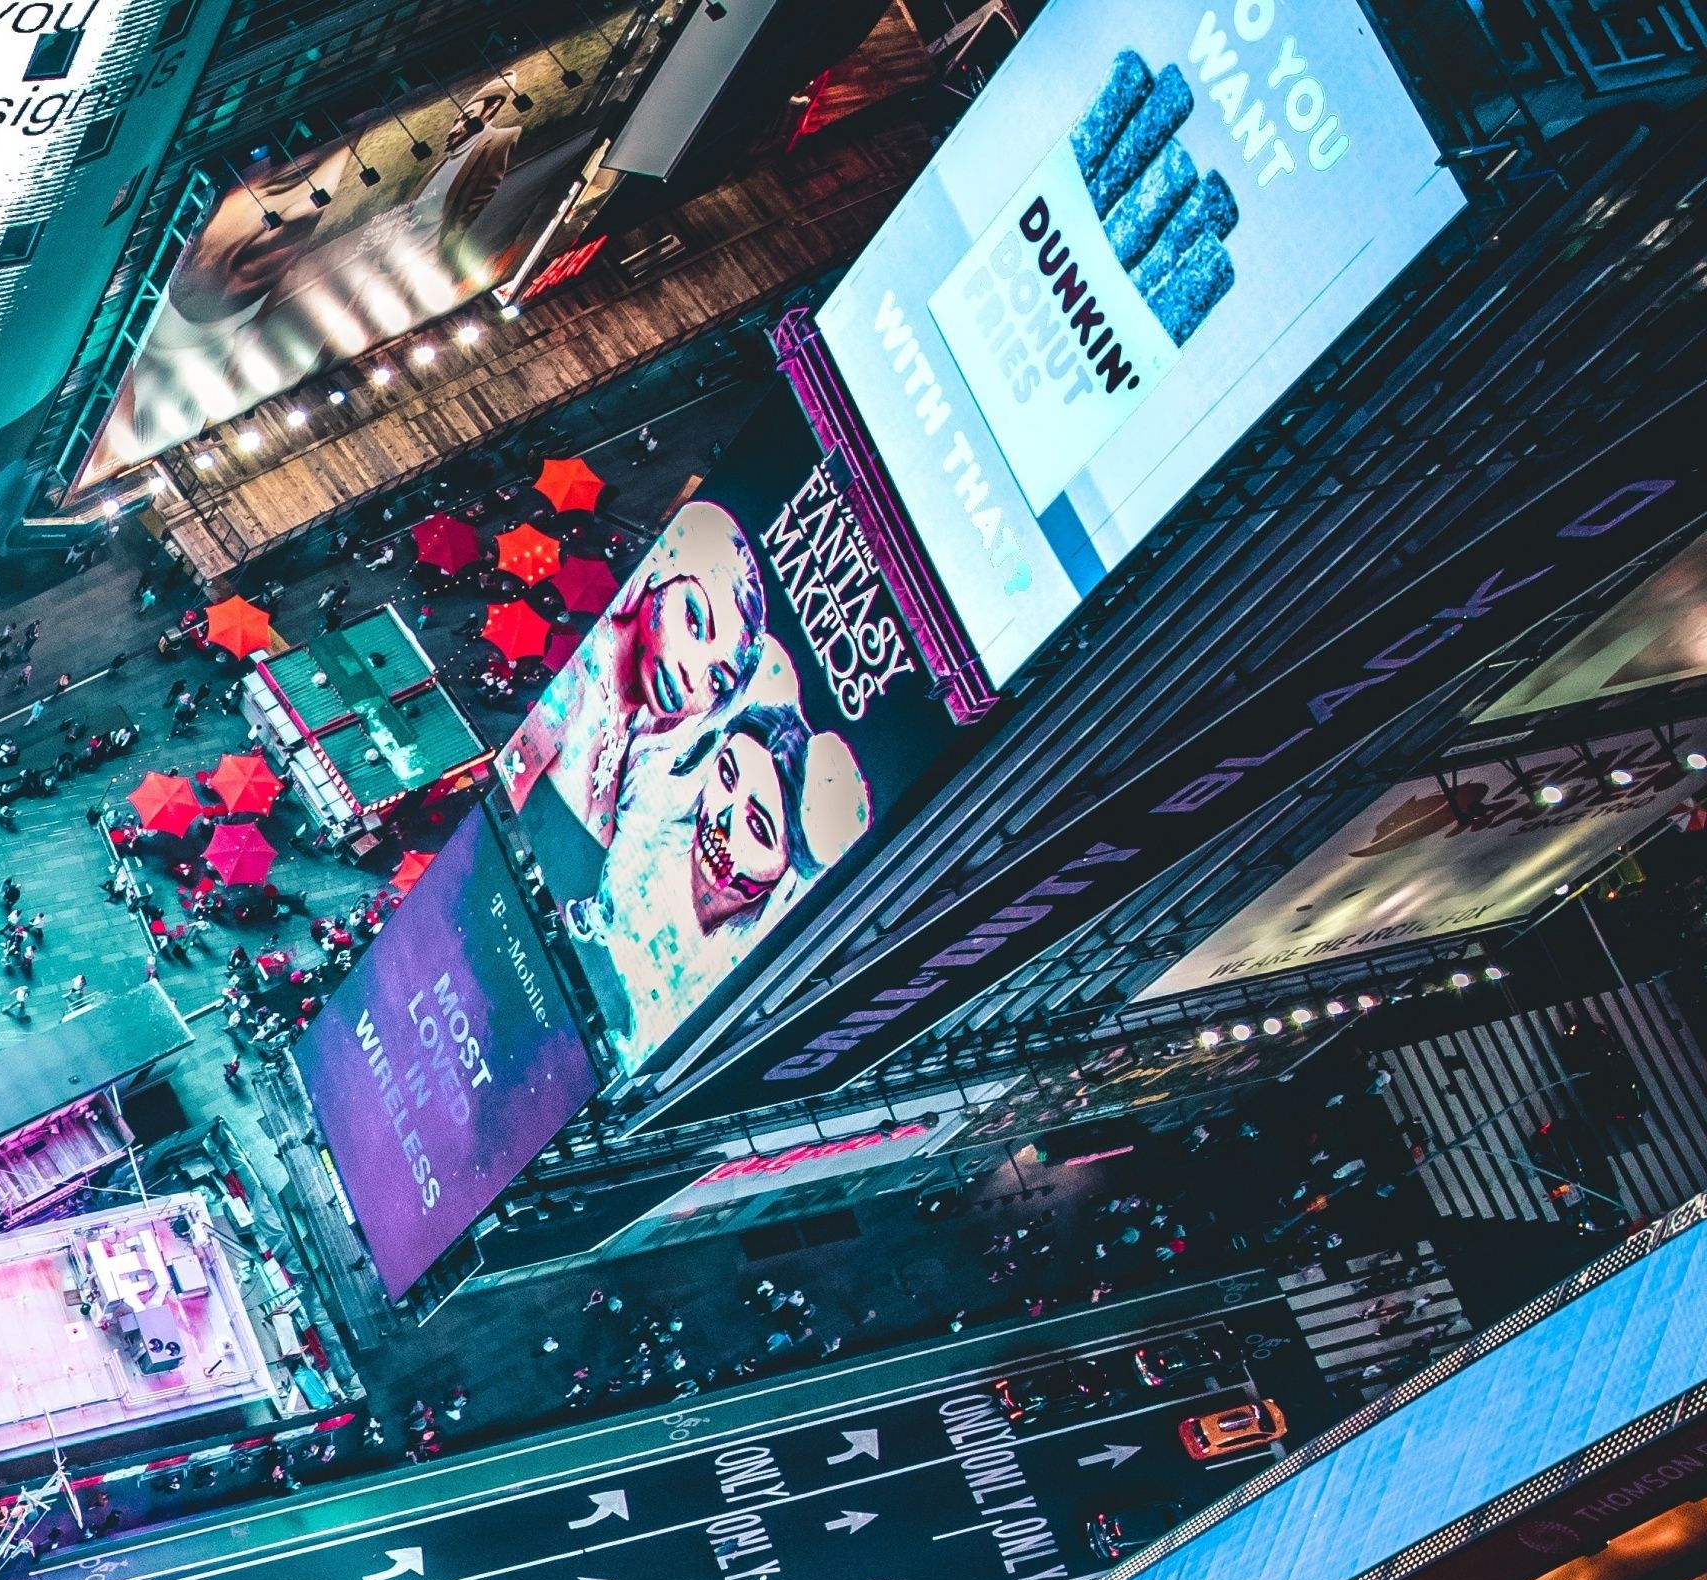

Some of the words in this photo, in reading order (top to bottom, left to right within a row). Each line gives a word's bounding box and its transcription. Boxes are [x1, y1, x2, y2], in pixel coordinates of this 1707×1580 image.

[1188, 10, 1295, 188] WANT
[1234, 0, 1275, 42] O
[1267, 35, 1350, 171] YOU
[964, 265, 1041, 404] FRIES
[990, 231, 1094, 405] DONUT
[1019, 196, 1140, 394] DUNKIN'
[875, 289, 952, 436] WITH
[943, 430, 1033, 596] THAT?
[759, 502, 877, 721] MAKERS
[790, 465, 916, 696] FANTASY
[1150, 564, 1554, 815] BLACK
[763, 980, 950, 1081] CALL
[920, 842, 1142, 968] DUTY
[1208, 960, 1248, 979] WE
[1249, 946, 1305, 970] ARE
[1304, 934, 1355, 958] THE
[1349, 920, 1430, 946] ARCTIC
[1437, 902, 1496, 928] FOX
[405, 1060, 433, 1110] IN
[408, 990, 471, 1127] LOVED
[434, 972, 492, 1089] MOST
[715, 1446, 790, 1503] ONLY
[938, 1393, 1017, 1451] ONLY
[961, 1450, 1037, 1516] ONLY
[1573, 1454, 1704, 1521] THOMSON
